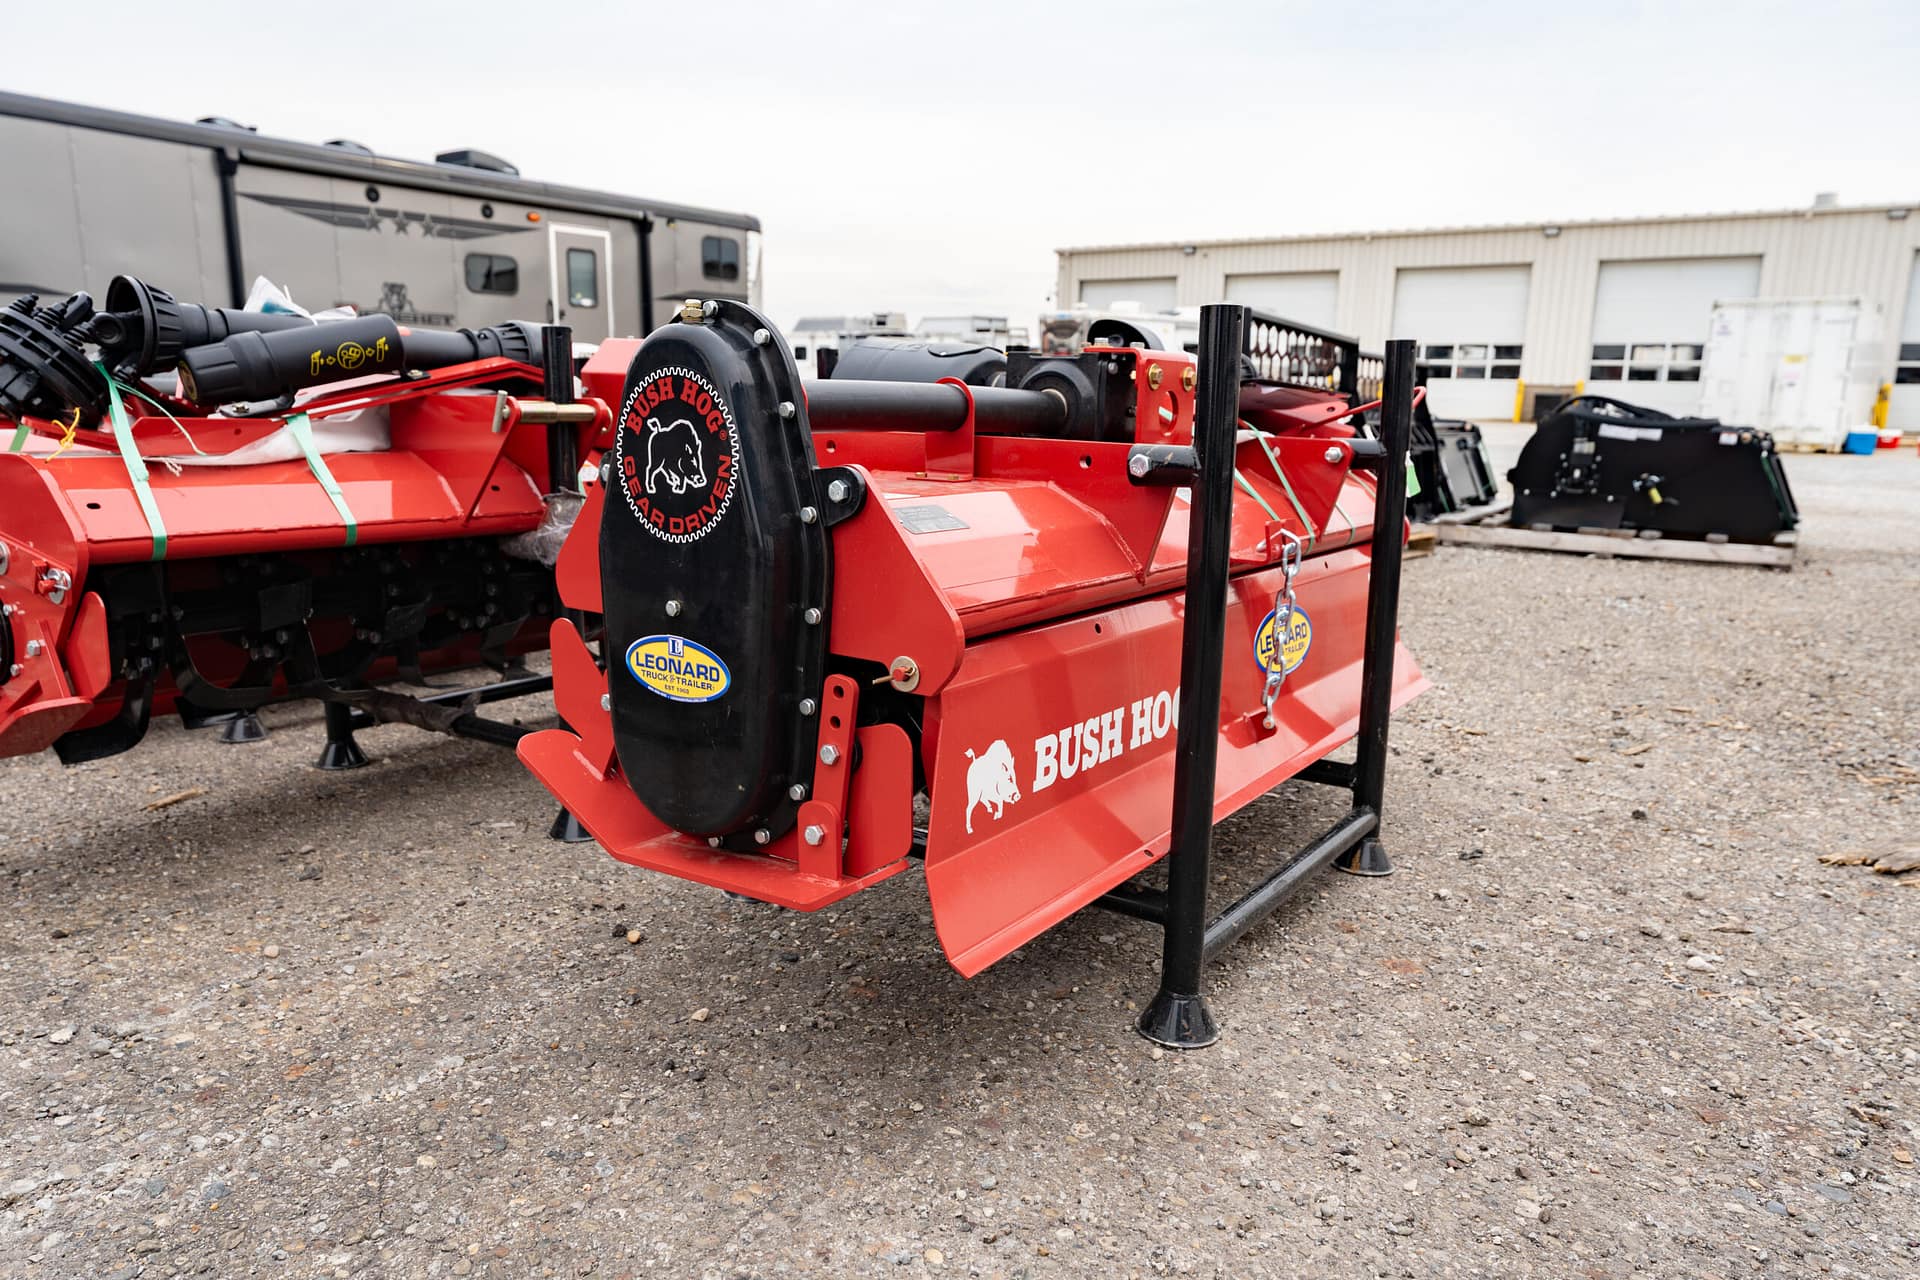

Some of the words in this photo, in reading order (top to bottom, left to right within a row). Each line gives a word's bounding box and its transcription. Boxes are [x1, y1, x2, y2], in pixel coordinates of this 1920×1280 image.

[626, 376, 675, 436] BUSH
[623, 455, 666, 529] GEAR
[669, 455, 732, 534] DRIVEN
[635, 651, 720, 682] LEONARD
[641, 669, 669, 682] TRUCK
[676, 676, 713, 691] TRAILER
[1033, 706, 1125, 793] BUSH
